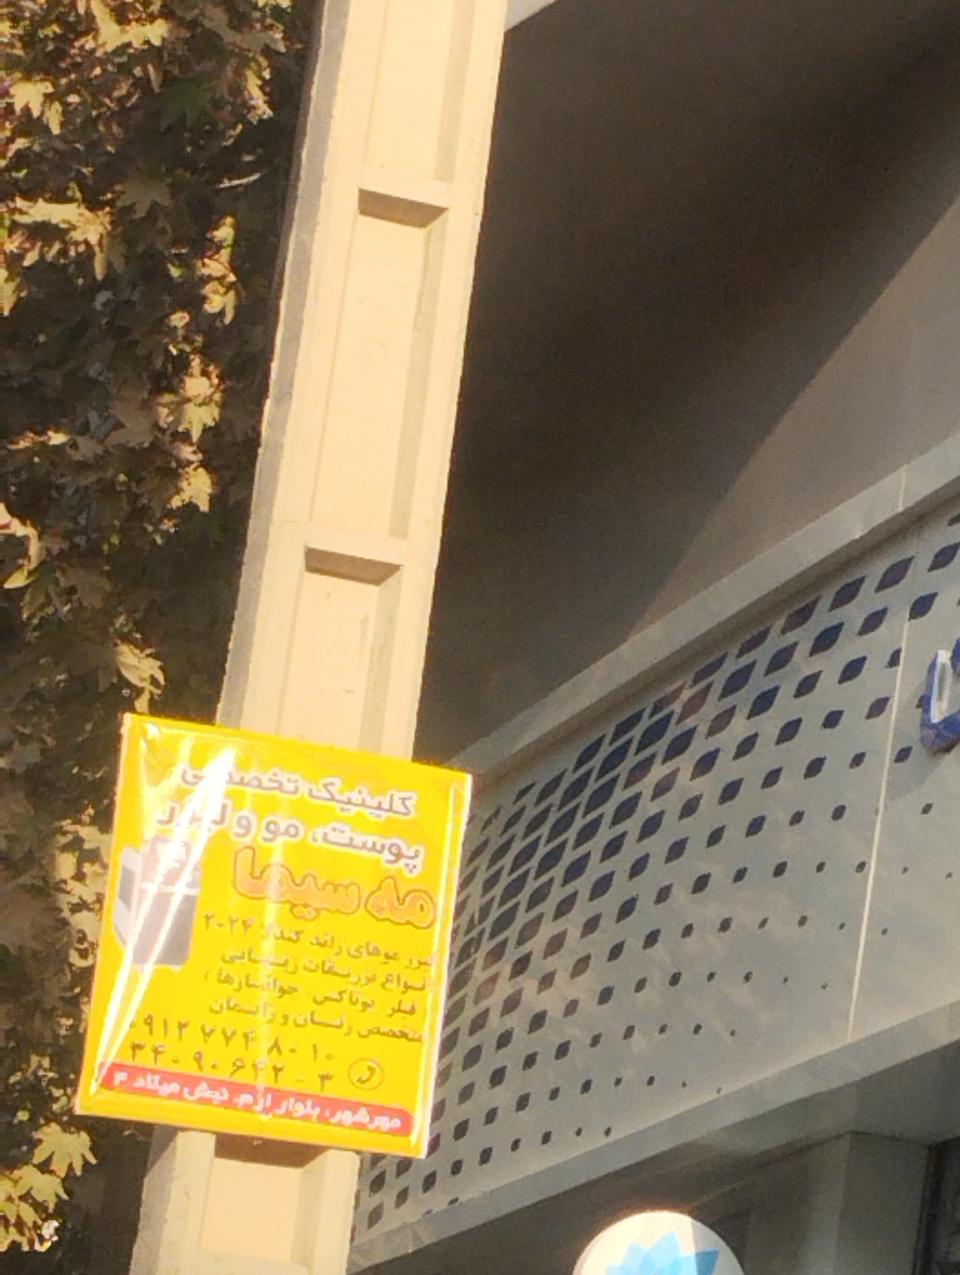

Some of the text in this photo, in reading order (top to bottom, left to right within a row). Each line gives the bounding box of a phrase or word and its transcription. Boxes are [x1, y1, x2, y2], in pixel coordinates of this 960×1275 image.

[180, 767, 414, 819] کلینیک تخصی
[234, 814, 253, 839] و
[262, 818, 301, 844] مو
[232, 844, 362, 922] سیما
